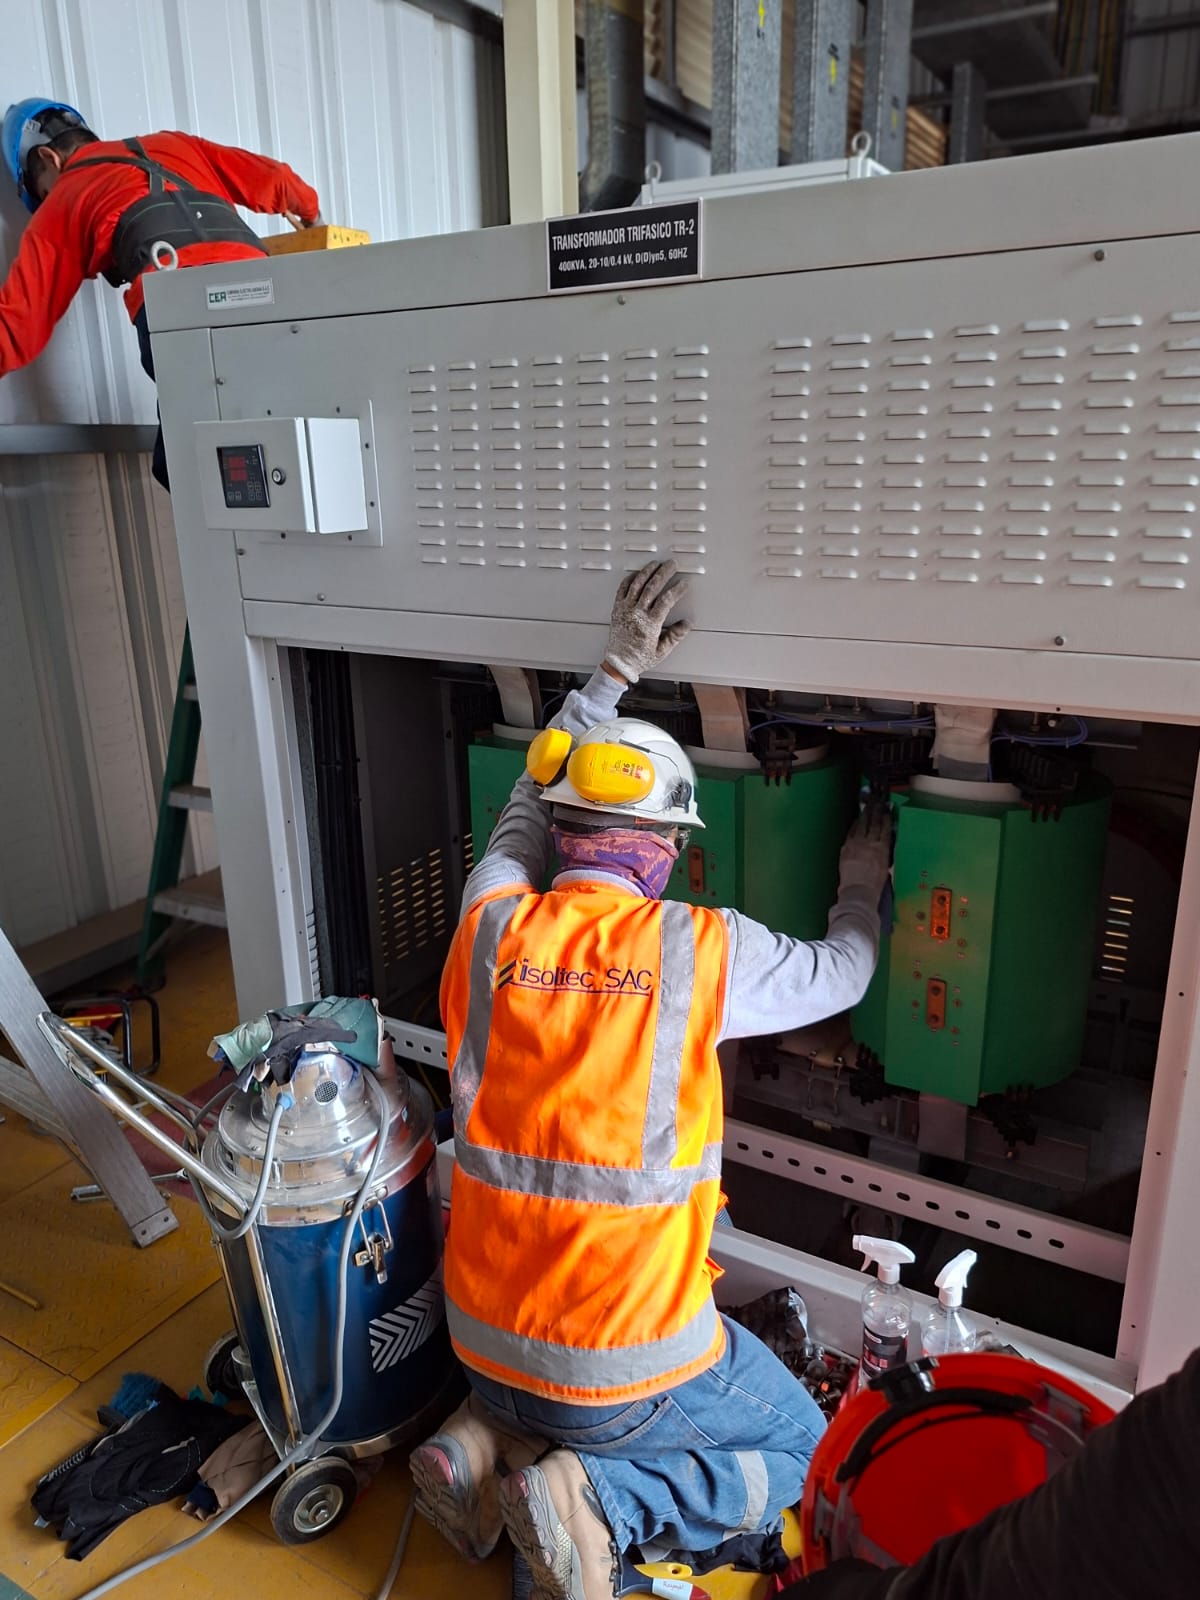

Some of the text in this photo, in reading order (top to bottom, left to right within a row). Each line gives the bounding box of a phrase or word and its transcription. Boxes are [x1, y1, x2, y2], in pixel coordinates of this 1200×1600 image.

[552, 219, 695, 251] TRANSFORMADOR TRIFASICO TR-2
[588, 255, 622, 269] 20-10/0.4
[668, 247, 688, 260] 60HZ
[520, 958, 653, 991] isoltec SAC
